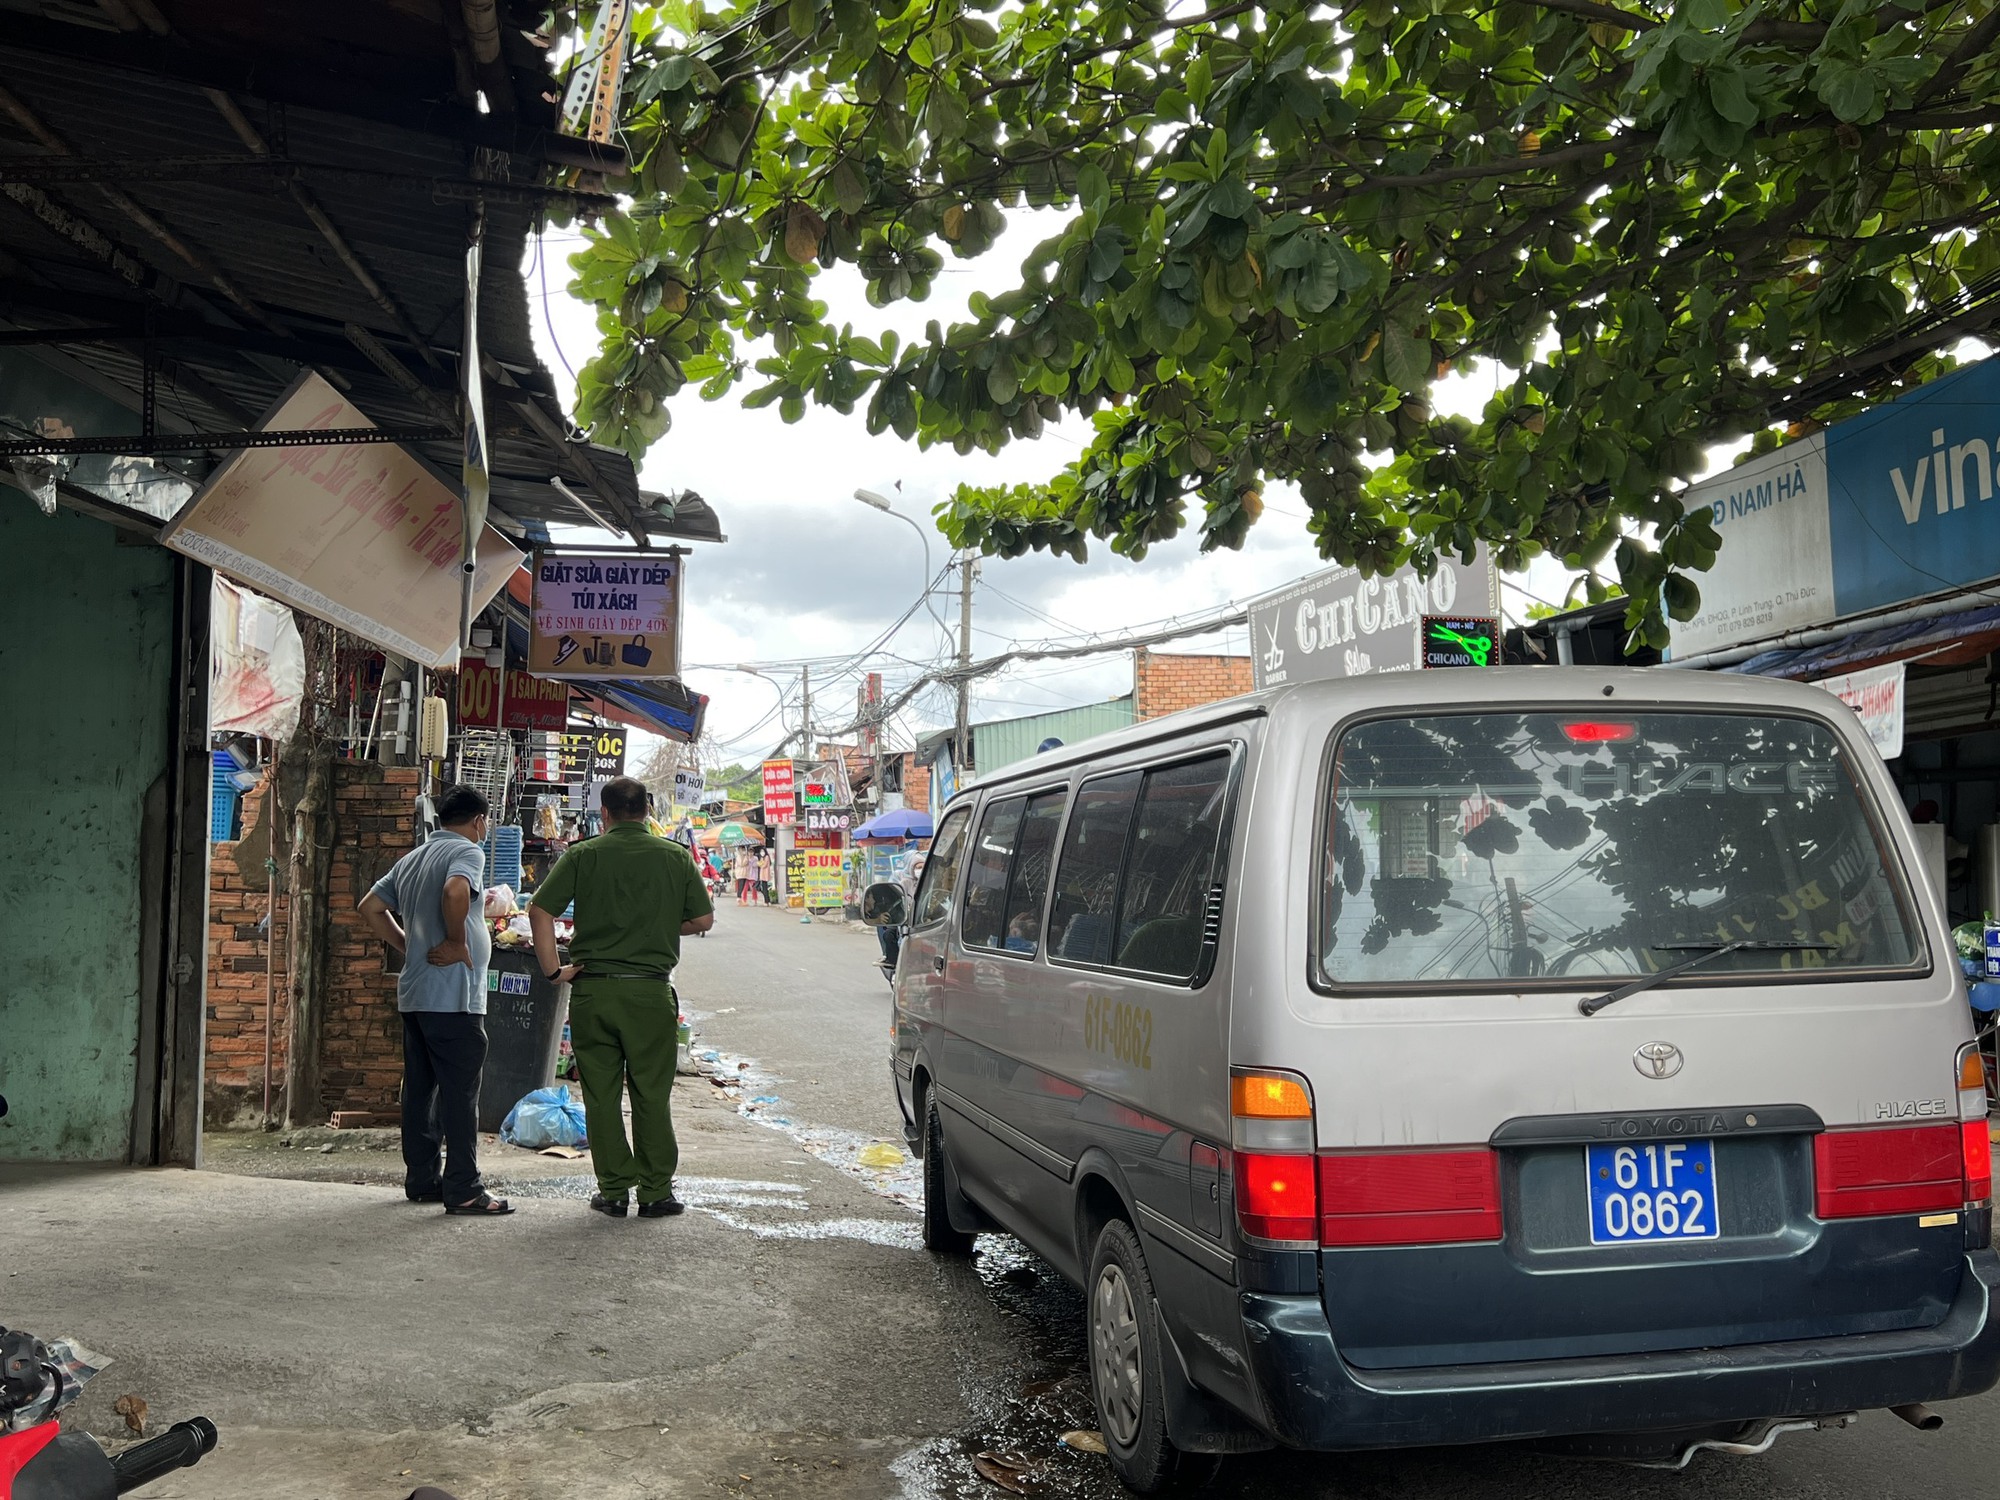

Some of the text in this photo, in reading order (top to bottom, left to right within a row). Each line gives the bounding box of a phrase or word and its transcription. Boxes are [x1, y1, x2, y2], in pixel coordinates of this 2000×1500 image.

[1889, 428, 2000, 525] vin
[1730, 480, 1772, 520] NAM
[1777, 462, 1807, 503] HÀ
[540, 559, 671, 586] GIẶT SỬA GIÀY DÉP
[571, 587, 638, 611] TÚI XÁCH
[1739, 605, 1753, 616] Linh
[556, 617, 584, 630] SINH
[588, 615, 615, 631] GIÀY
[620, 616, 642, 631] DÉP
[646, 619, 668, 632] 40K
[1446, 621, 1460, 629] NAM
[1729, 621, 1742, 632] 079
[1427, 652, 1470, 665] CHICANO
[1569, 762, 1838, 795] HIACE
[1084, 994, 1152, 1071] 61F-0862
[1874, 1099, 1947, 1119] HIACE
[1601, 1114, 1728, 1137] TOYOTA
[1614, 1144, 1687, 1190] 61F
[1605, 1189, 1706, 1237] 0862
